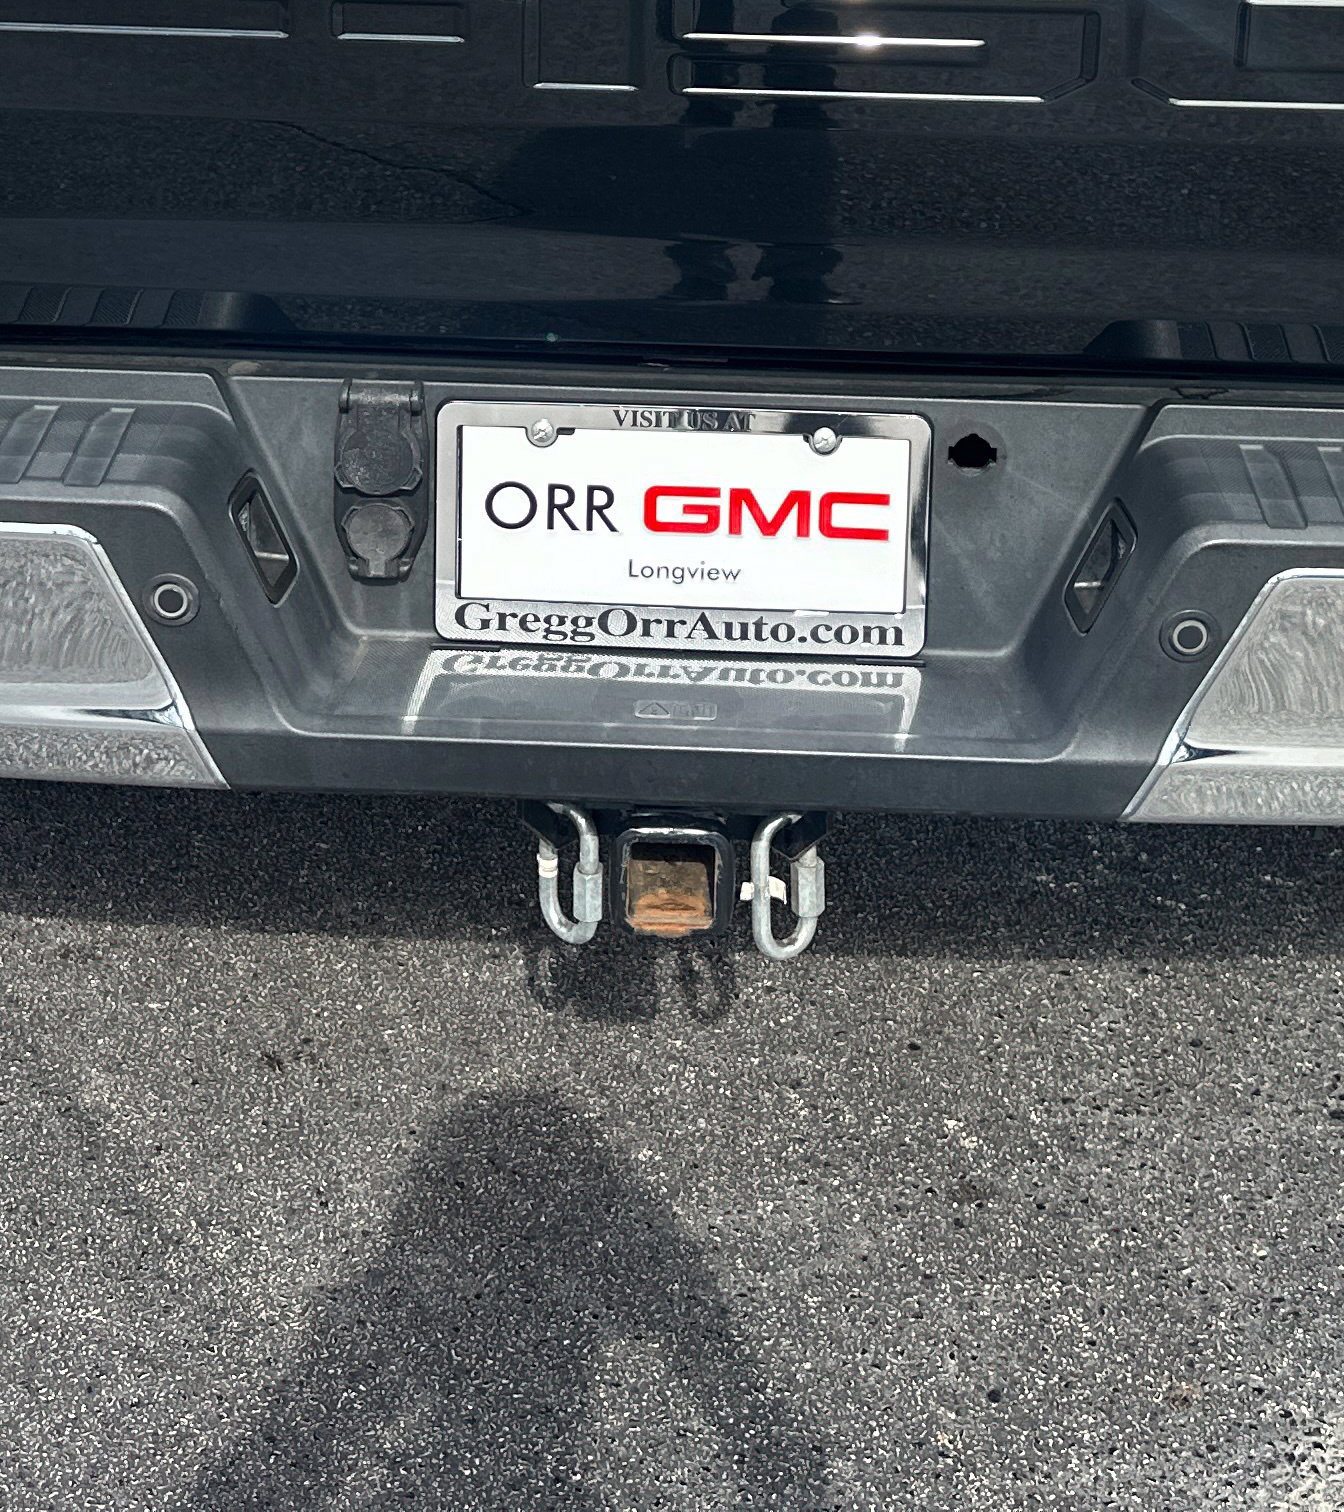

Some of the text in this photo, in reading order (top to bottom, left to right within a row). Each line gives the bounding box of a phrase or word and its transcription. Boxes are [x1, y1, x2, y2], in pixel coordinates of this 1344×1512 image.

[612, 408, 756, 432] VISIT US AT
[484, 480, 891, 542] ORR GMC
[628, 558, 742, 585] Longview
[454, 601, 904, 646] GreggOrrAuto.com
